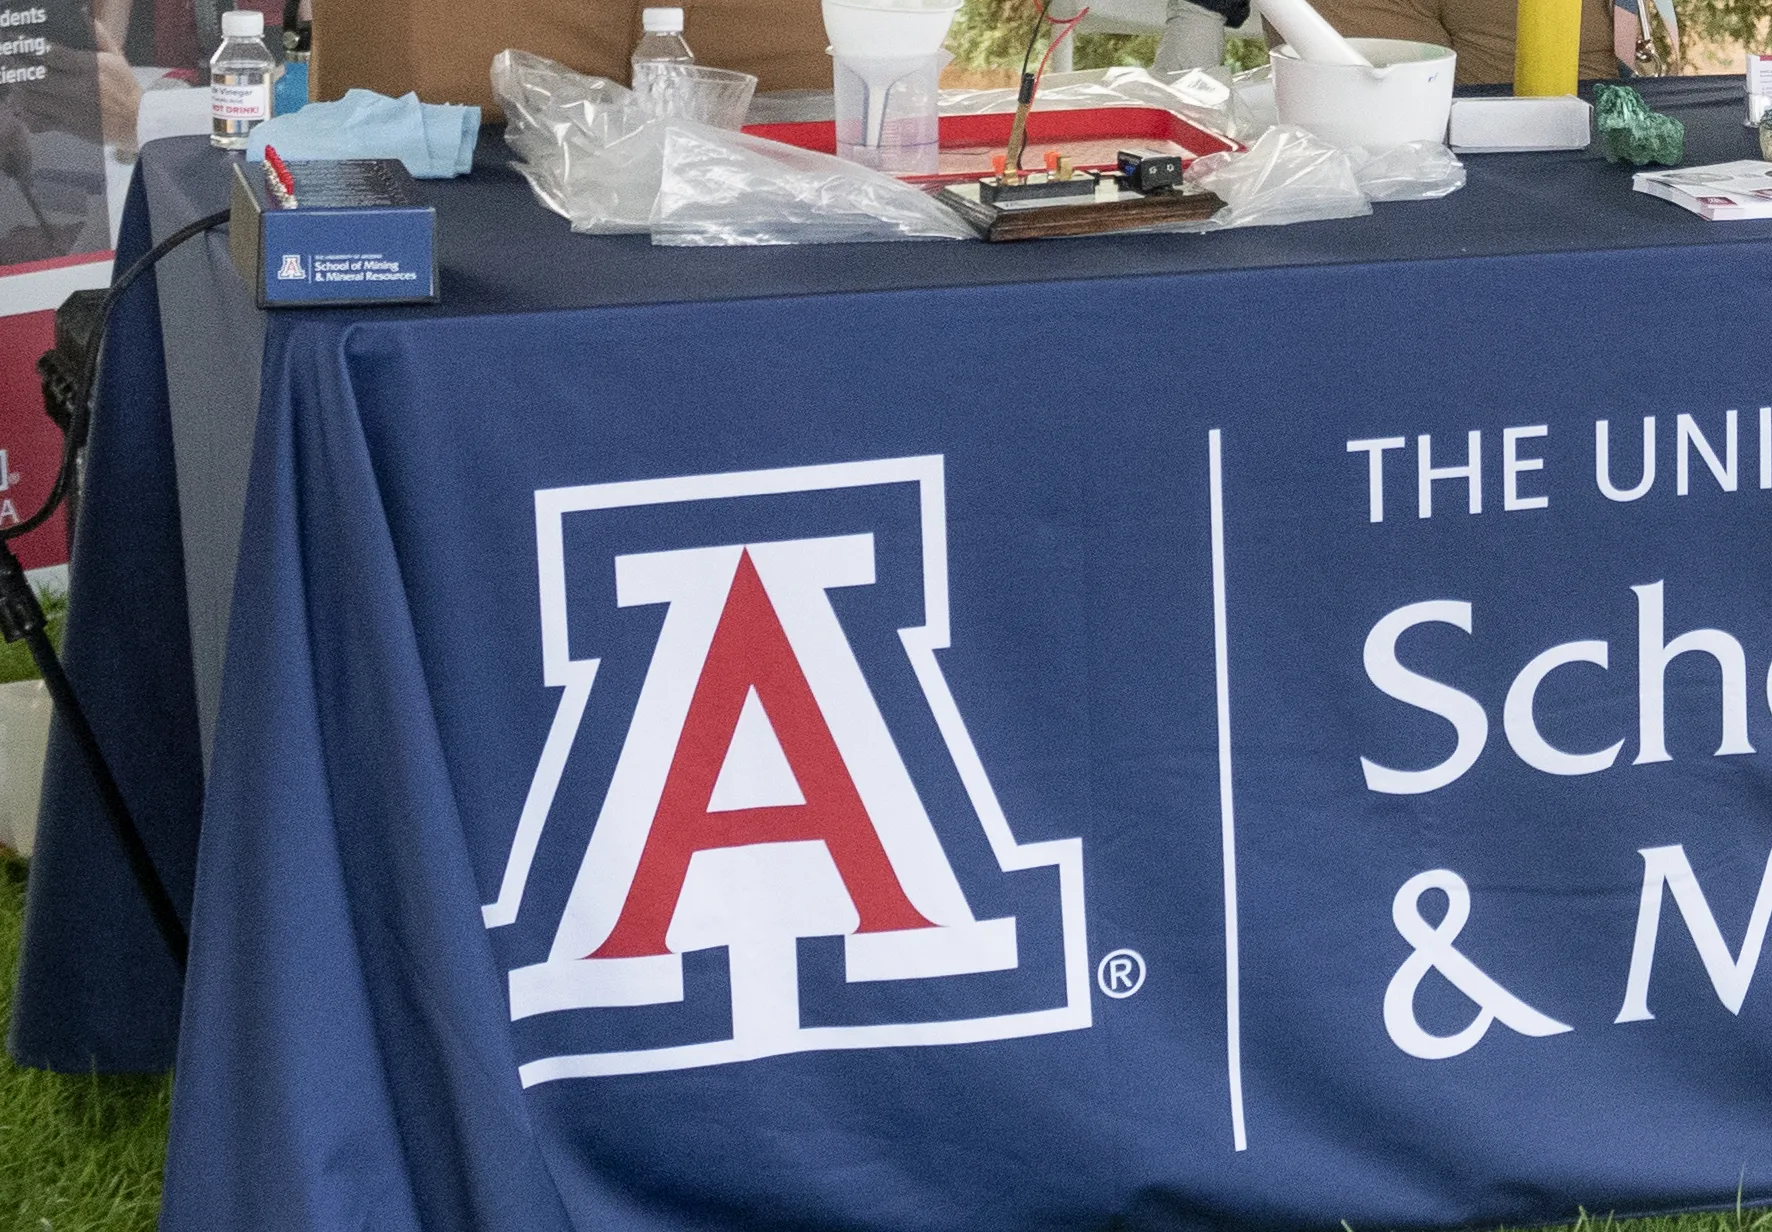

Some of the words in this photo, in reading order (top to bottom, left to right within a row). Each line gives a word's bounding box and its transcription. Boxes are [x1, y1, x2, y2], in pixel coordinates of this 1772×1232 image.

[0, 35, 52, 56] ering,
[0, 65, 47, 84] ience
[220, 87, 253, 98] Vinegar
[226, 105, 260, 115] DRINK!
[314, 261, 349, 271] School
[351, 261, 362, 270] of
[363, 261, 399, 272] Mining
[315, 272, 325, 282] &
[326, 271, 364, 281] Mineral
[366, 271, 416, 281] Resources
[1346, 424, 1549, 523] THE
[1383, 868, 1574, 1060] &
